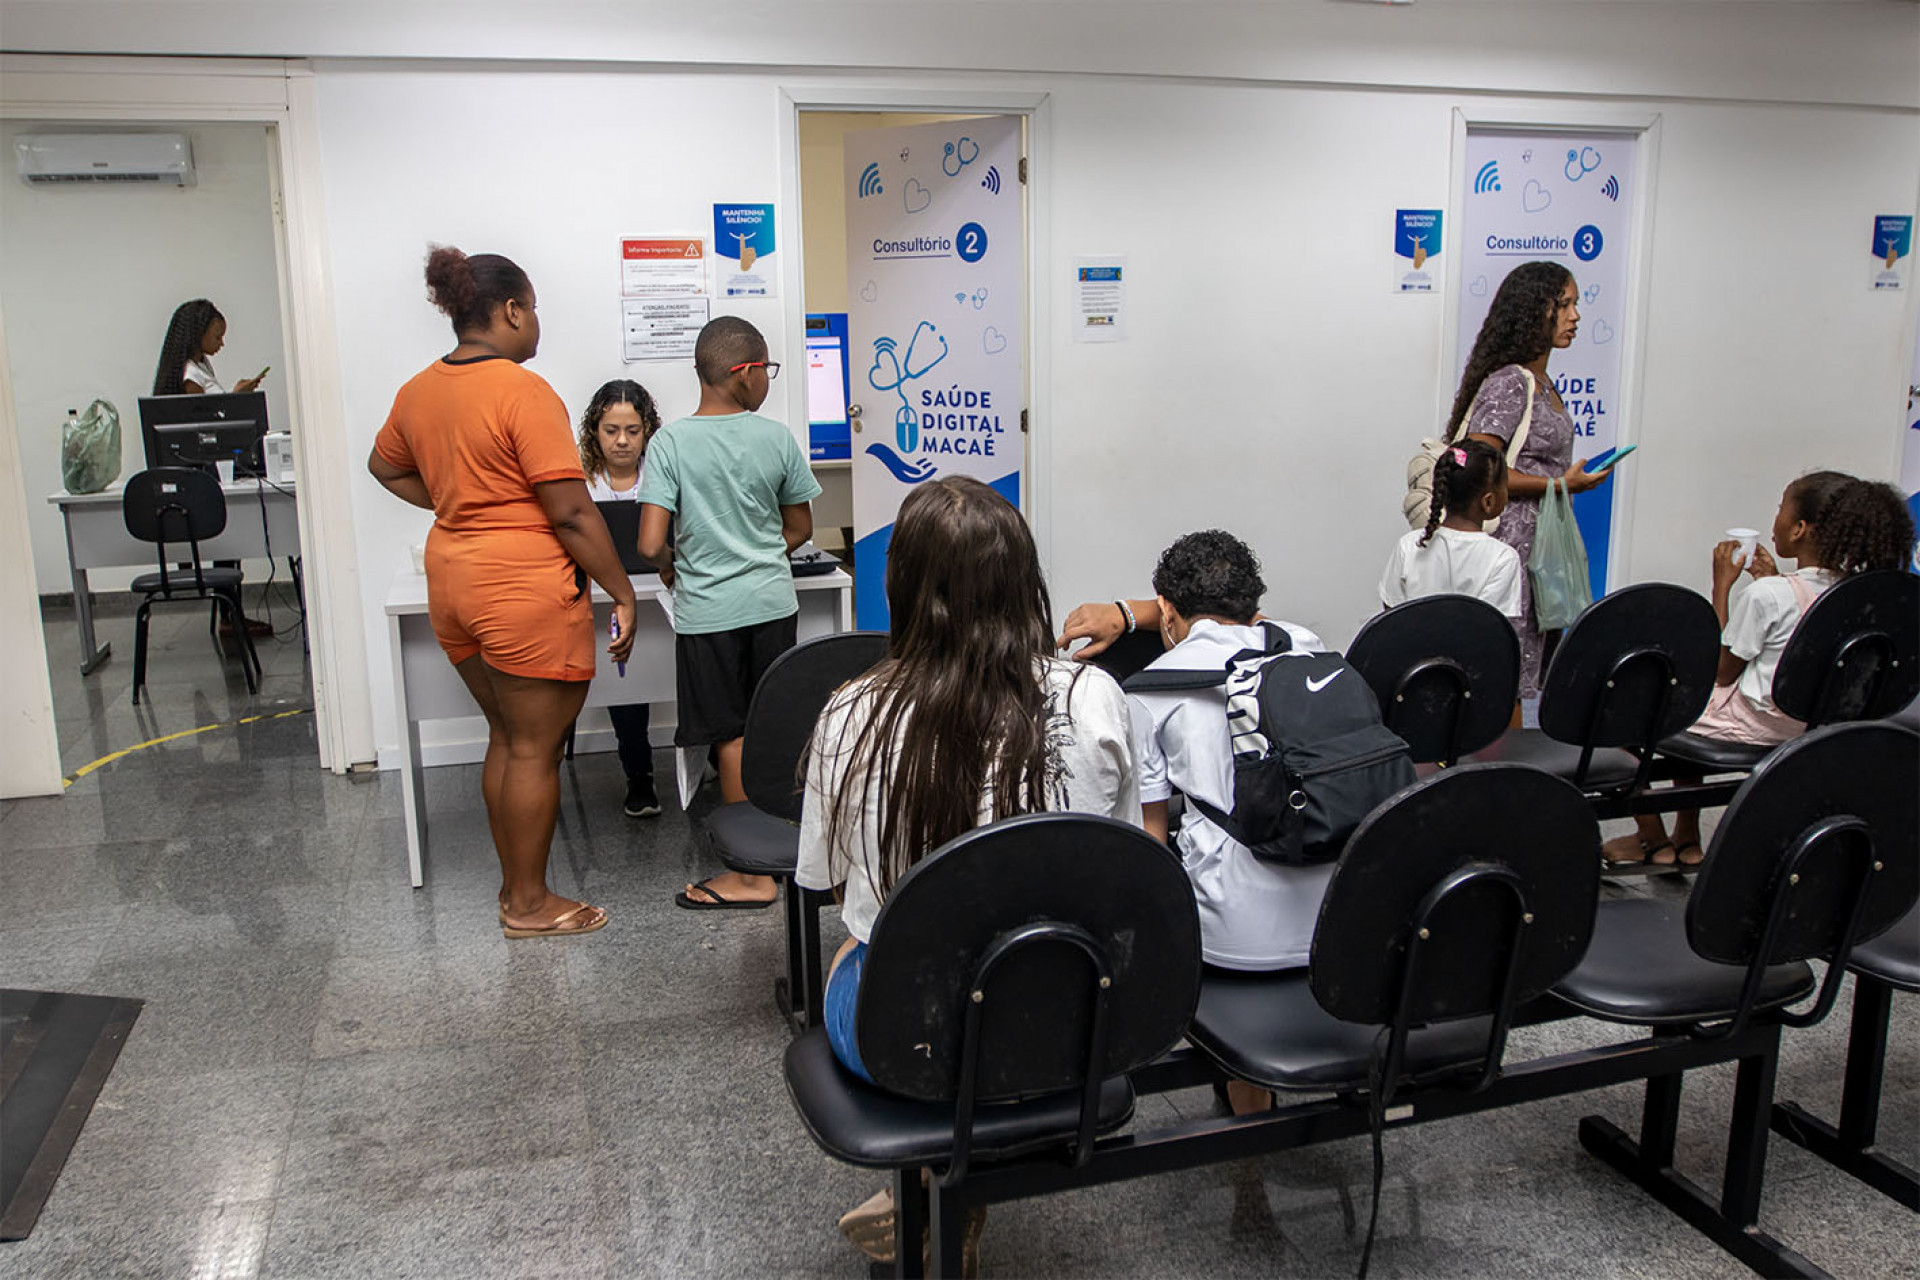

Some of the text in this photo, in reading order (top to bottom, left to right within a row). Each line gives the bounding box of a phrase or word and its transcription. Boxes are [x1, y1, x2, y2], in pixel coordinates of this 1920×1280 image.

[873, 231, 978, 254] Consultório 2
[1486, 232, 1594, 254] Consultório 3
[1555, 372, 1596, 394] ÚDE
[921, 384, 991, 408] SAÚDE
[922, 413, 1005, 433] DIGITAL
[922, 433, 995, 456] MACAÉ
